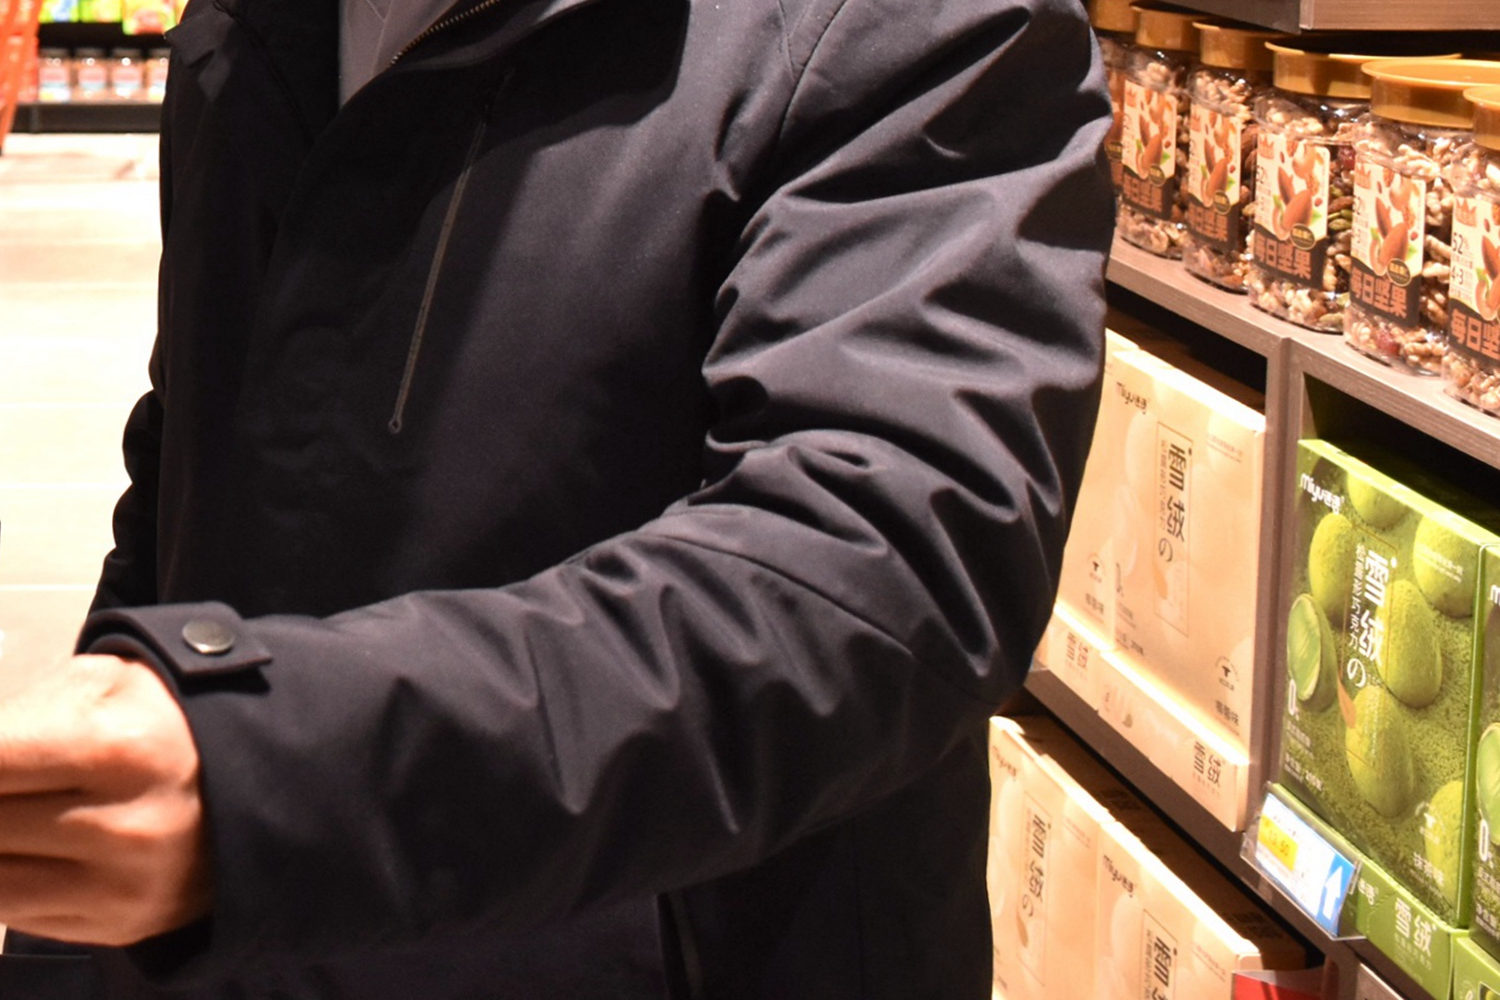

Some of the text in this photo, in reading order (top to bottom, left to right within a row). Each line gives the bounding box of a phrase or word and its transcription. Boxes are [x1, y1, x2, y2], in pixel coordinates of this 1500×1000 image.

[1253, 229, 1312, 280] 每日坚果
[1351, 265, 1408, 319] 每日坚果
[1394, 896, 1435, 958] 雪绒
[1152, 936, 1173, 1000] 雪
